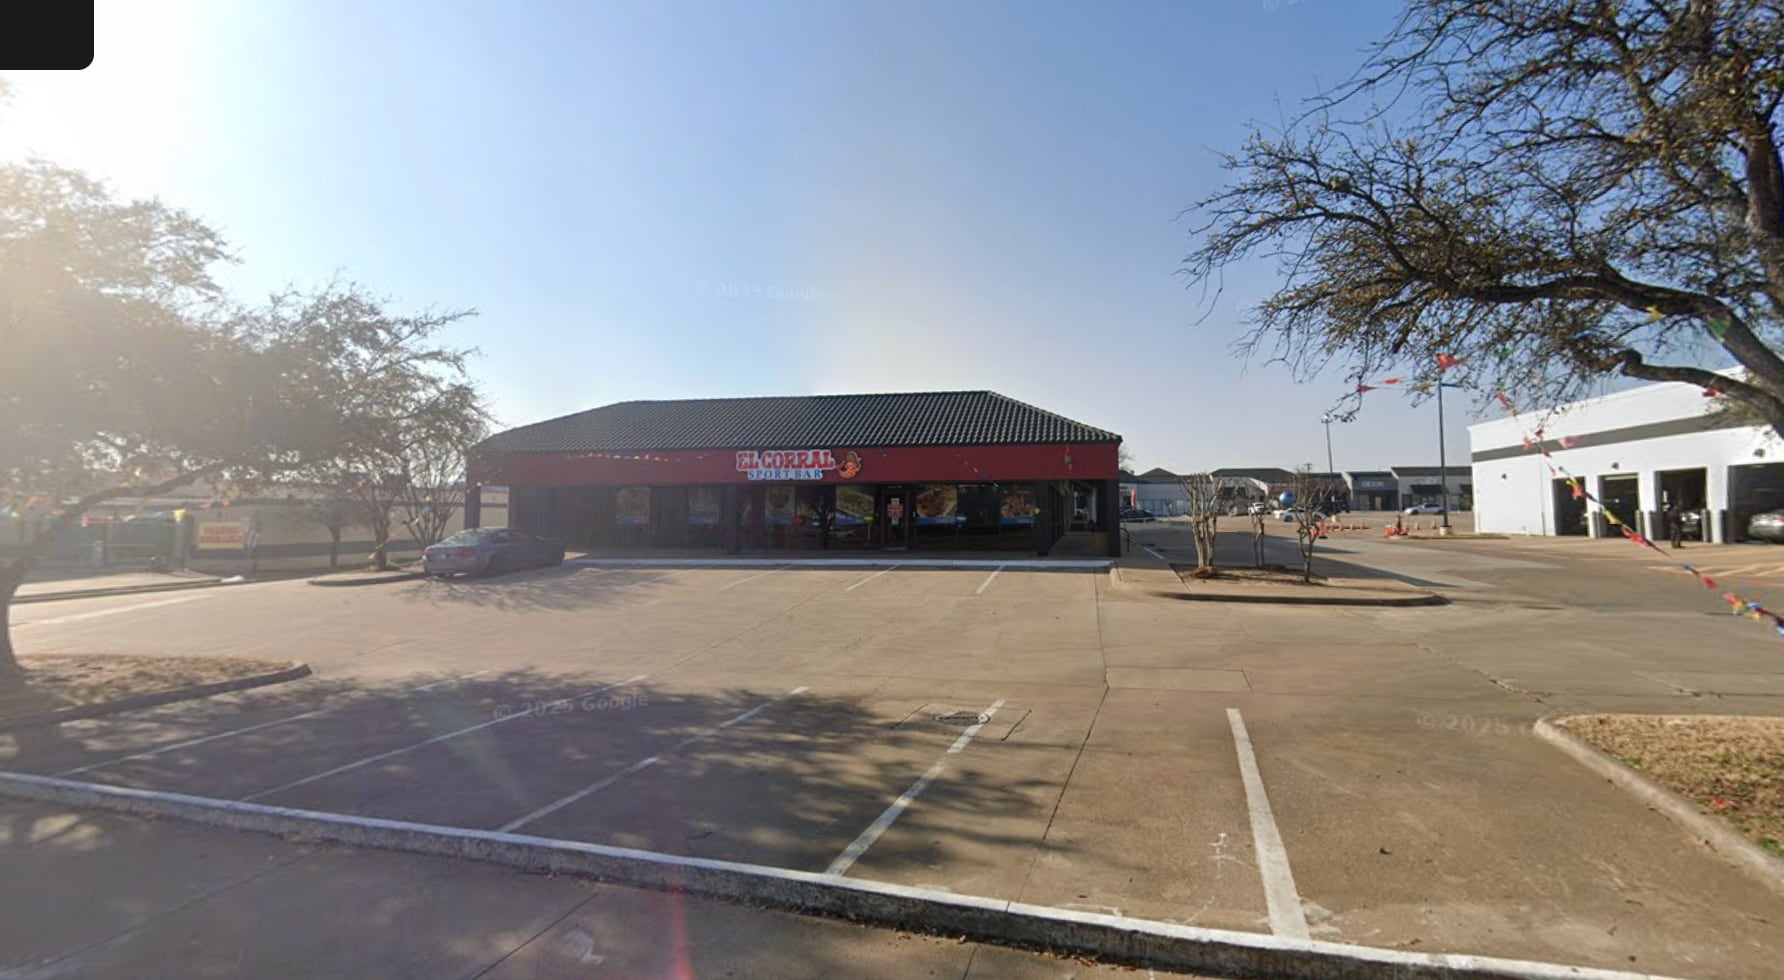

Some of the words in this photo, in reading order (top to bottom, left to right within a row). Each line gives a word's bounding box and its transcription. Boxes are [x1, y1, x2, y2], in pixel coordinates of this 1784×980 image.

[736, 451, 759, 471] EL
[760, 449, 836, 470] CORRAL
[748, 469, 790, 480] SPORT
[794, 469, 823, 479] BAR
